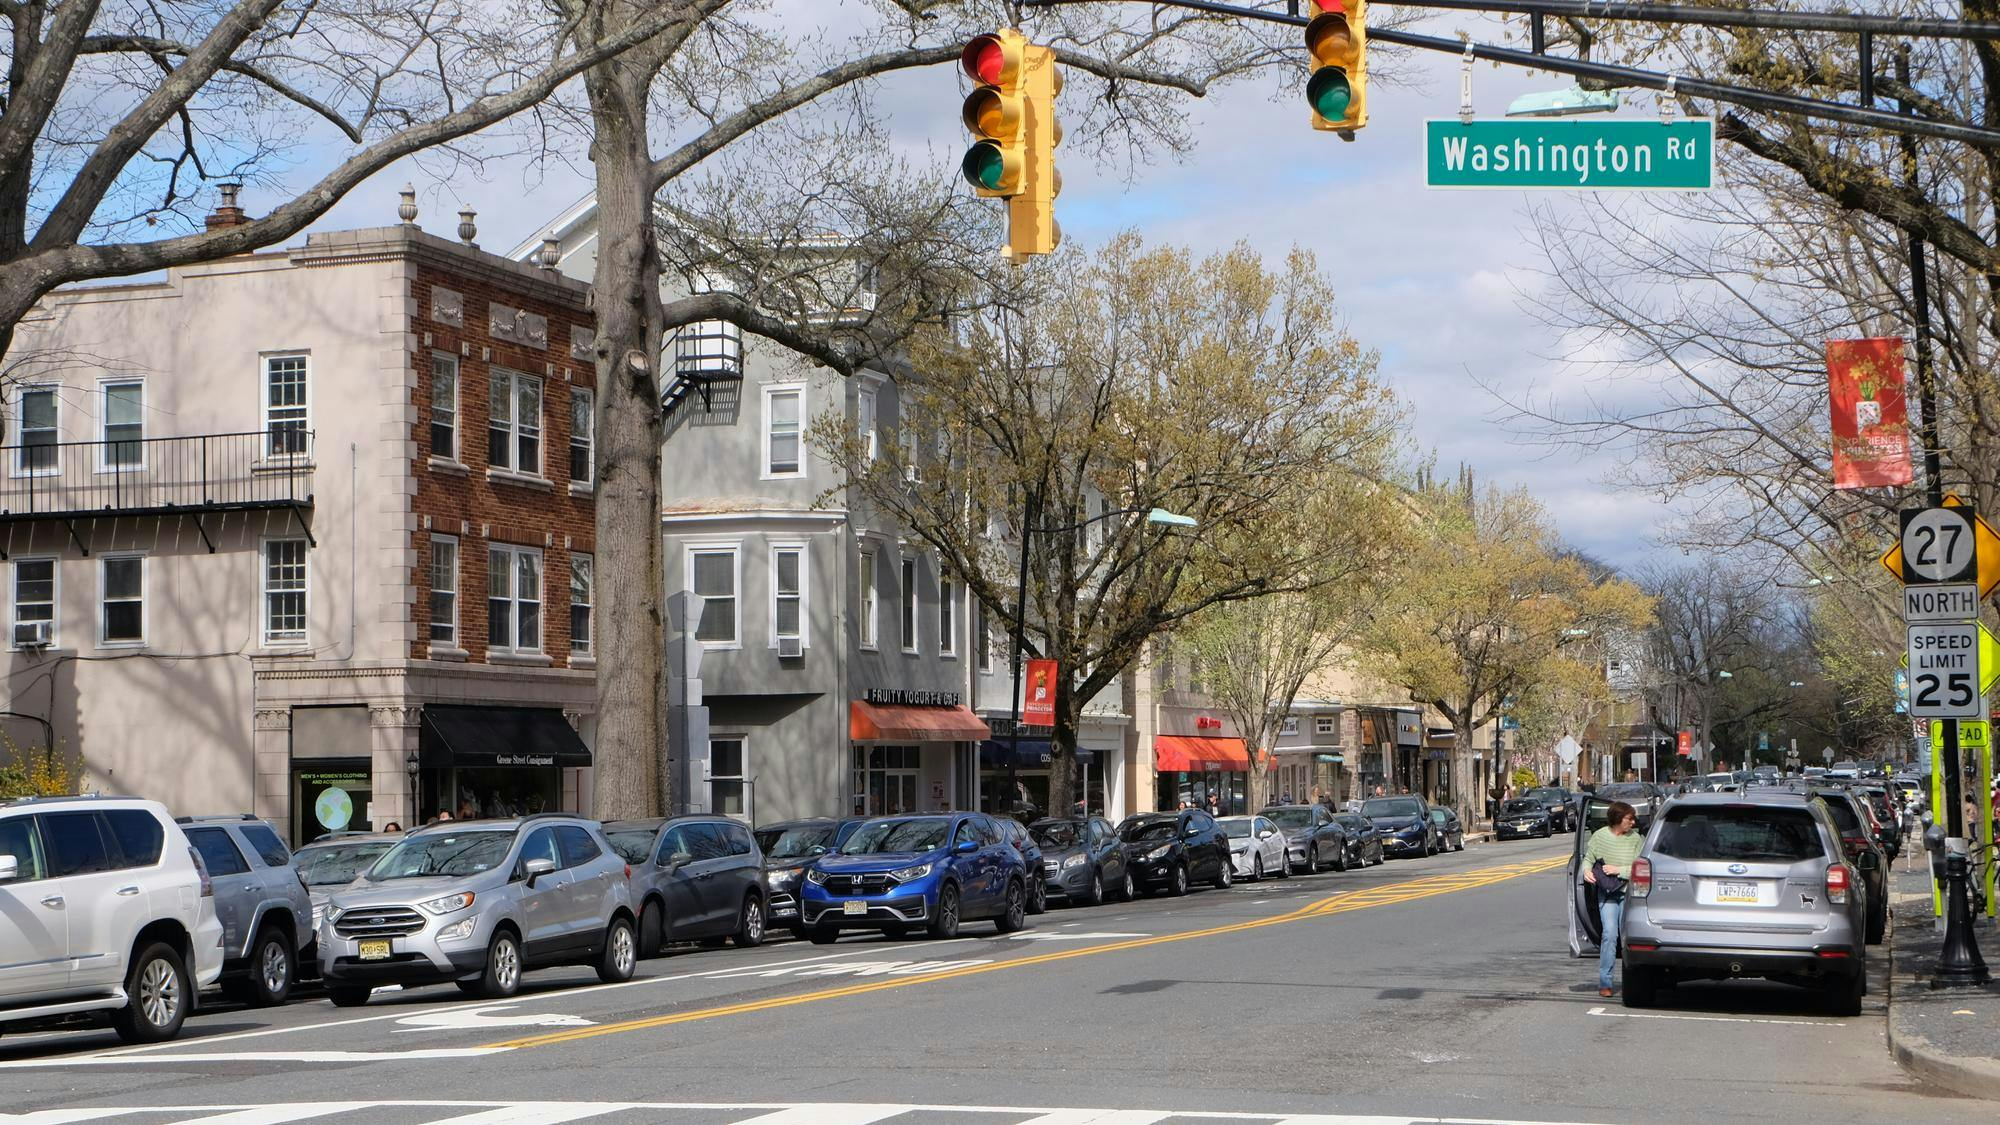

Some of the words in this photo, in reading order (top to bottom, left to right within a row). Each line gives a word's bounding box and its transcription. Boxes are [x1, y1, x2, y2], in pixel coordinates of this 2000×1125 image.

[1443, 137, 1651, 184] Washington
[1667, 137, 1696, 159] Rd
[1915, 525, 1962, 565] 27
[1909, 592, 1974, 613] NORTH
[1914, 635, 1972, 649] SPEED
[1920, 654, 1967, 668] LIMIT
[872, 689, 901, 703] FRUITY
[905, 690, 934, 705] YOGURT
[1915, 673, 1973, 707] 25
